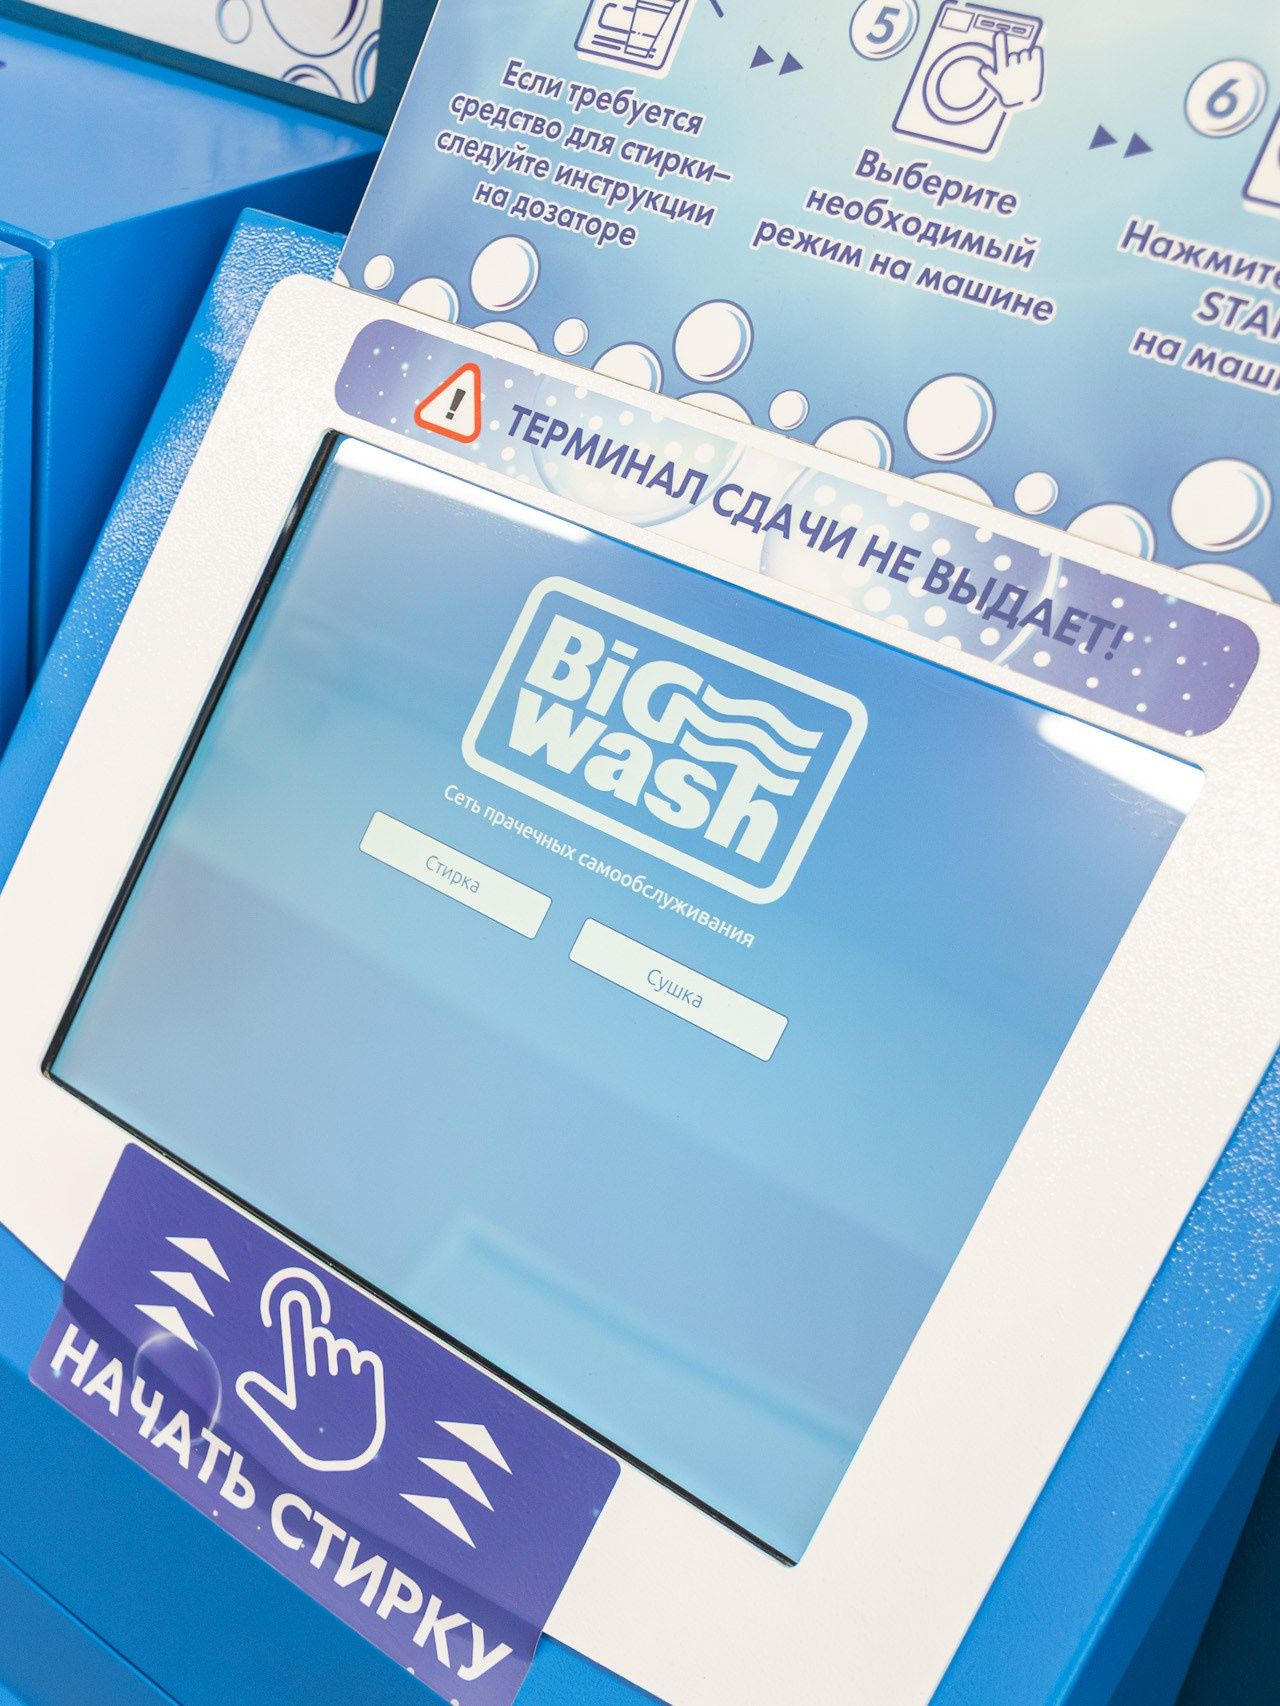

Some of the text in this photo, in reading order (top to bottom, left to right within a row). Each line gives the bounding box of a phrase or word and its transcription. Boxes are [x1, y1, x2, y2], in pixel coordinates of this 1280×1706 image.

[867, 6, 897, 44] 5
[450, 92, 561, 143] средство
[565, 122, 616, 155] для
[502, 60, 702, 136] Если требуется
[1206, 78, 1240, 121] 6
[436, 130, 715, 230] следуйте инструкции
[475, 183, 637, 248] на дозаторе
[855, 149, 1017, 217] Выберите
[806, 189, 1037, 270] необходимый
[753, 219, 1055, 324] режим на машине
[1132, 331, 1181, 361] на
[508, 404, 1130, 661] ТЕРМИНАЛ СДАЧИ НЕ ВЫДАЕТ!
[508, 686, 779, 863] wash
[425, 853, 480, 895] Стирка
[444, 784, 756, 949] Сеть прачечных самообслуживания
[647, 967, 703, 1010] Сушка
[50, 1323, 513, 1682] НАЧАТЬ СТИРКУ
